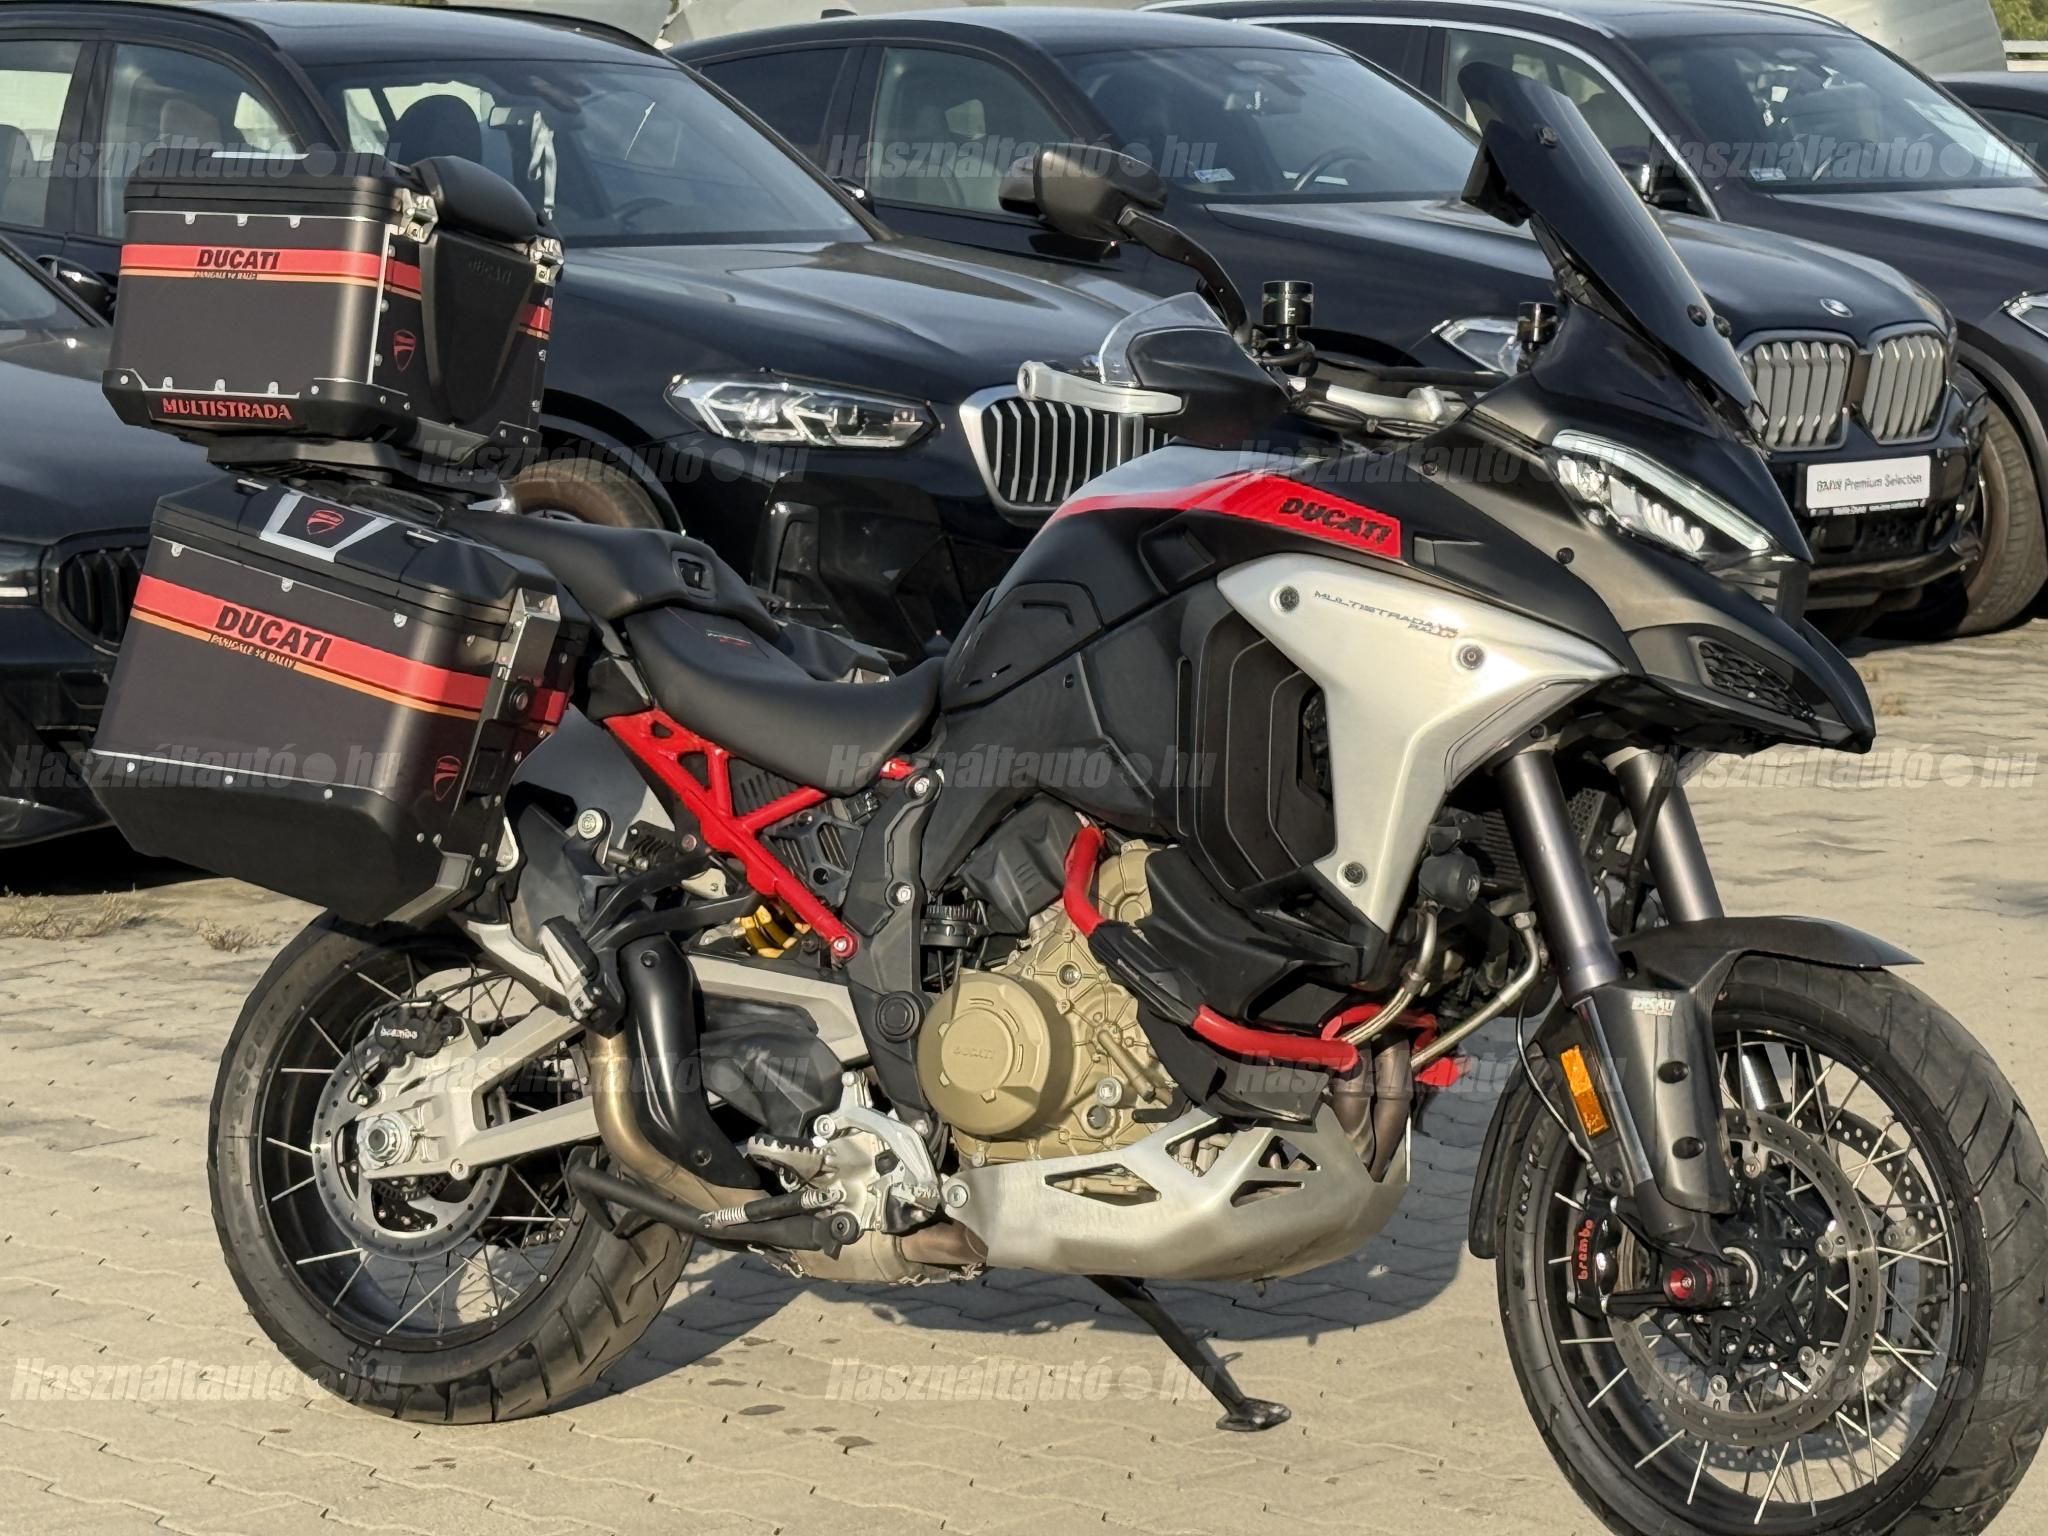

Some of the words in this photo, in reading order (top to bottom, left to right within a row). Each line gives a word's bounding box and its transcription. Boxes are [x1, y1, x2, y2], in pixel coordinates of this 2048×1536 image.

[197, 249, 281, 270] DUCATI
[163, 398, 292, 420] MULTISTRADA
[1845, 478, 1883, 491] Premium
[1885, 473, 1922, 487] Selection
[1279, 497, 1393, 544] DUCATI
[1314, 590, 1433, 629] MULTISTRADA
[215, 605, 333, 662] DUCATI
[267, 652, 296, 669] RALLY
[1578, 1219, 1595, 1280] brembo
